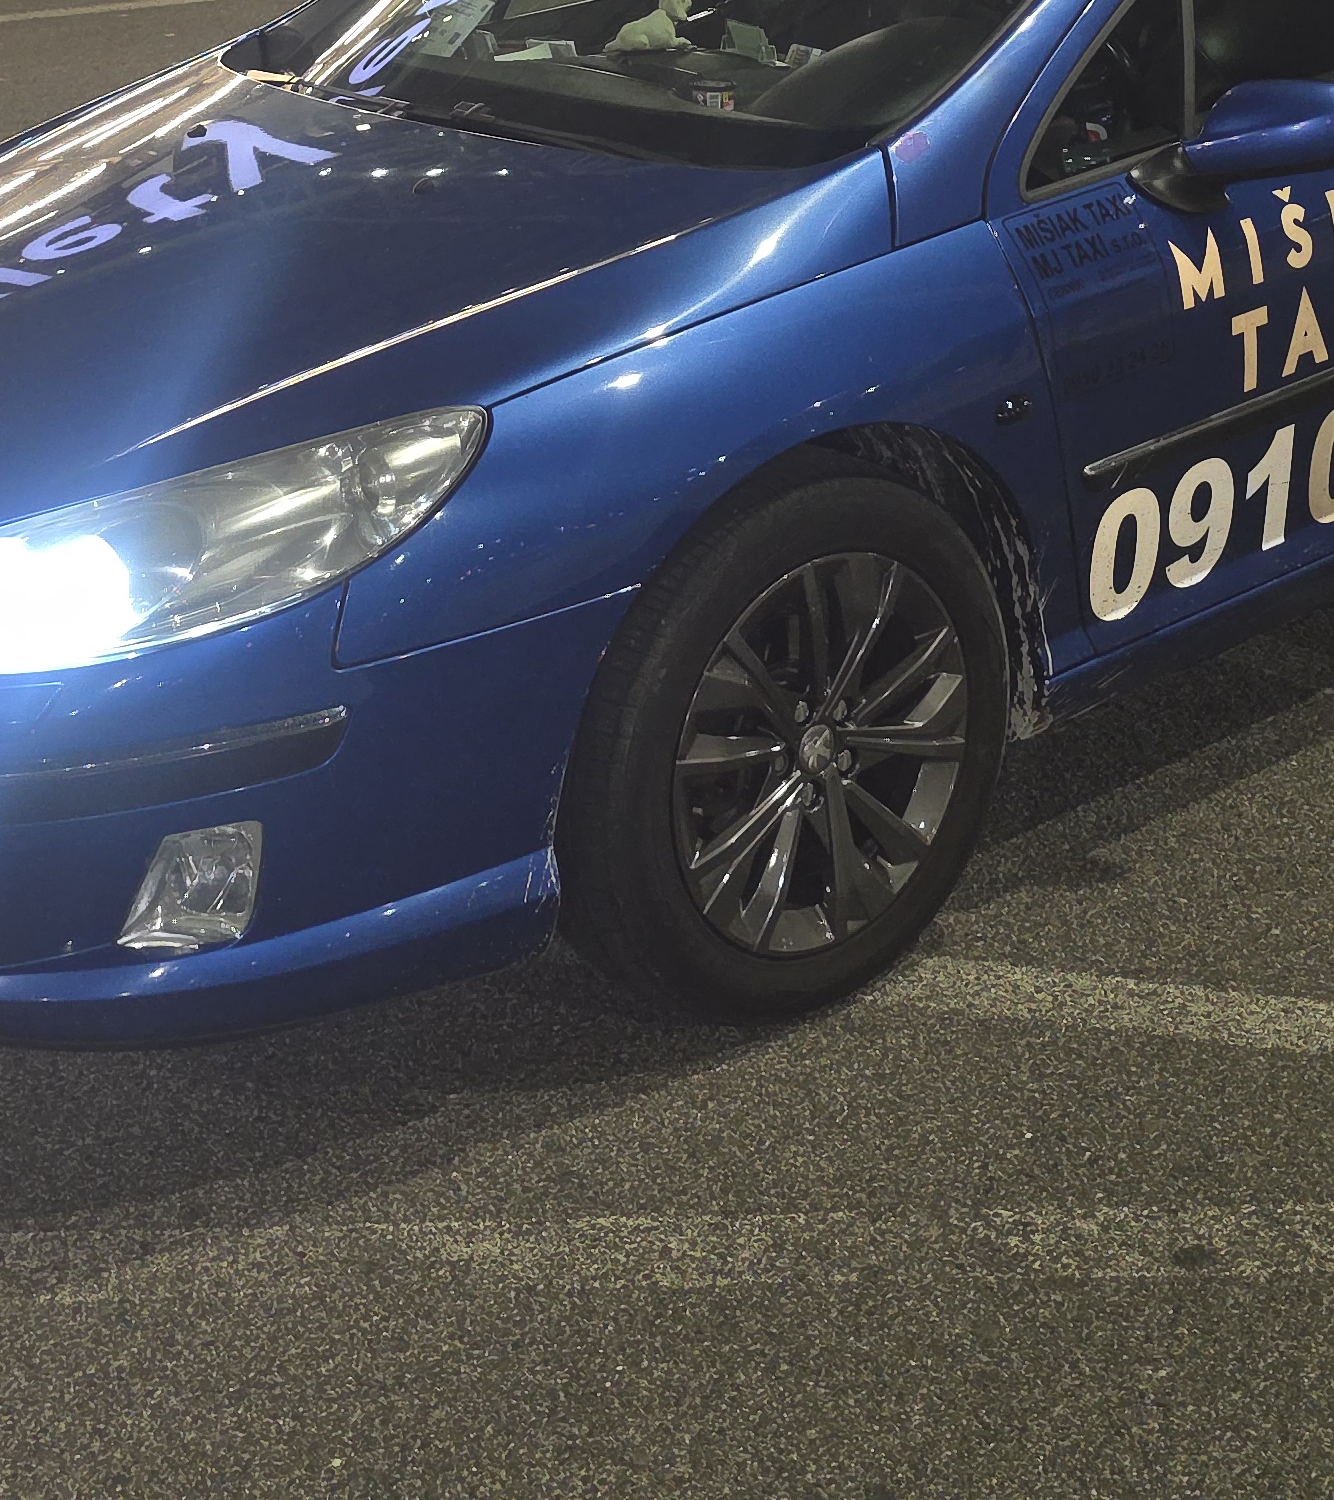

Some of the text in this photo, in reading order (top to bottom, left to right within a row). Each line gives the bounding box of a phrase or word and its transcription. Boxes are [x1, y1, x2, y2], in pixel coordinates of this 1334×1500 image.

[1015, 193, 1133, 251] MIŠIAK TAXI
[1031, 248, 1065, 280] MJ
[1065, 233, 1110, 268] TAXI
